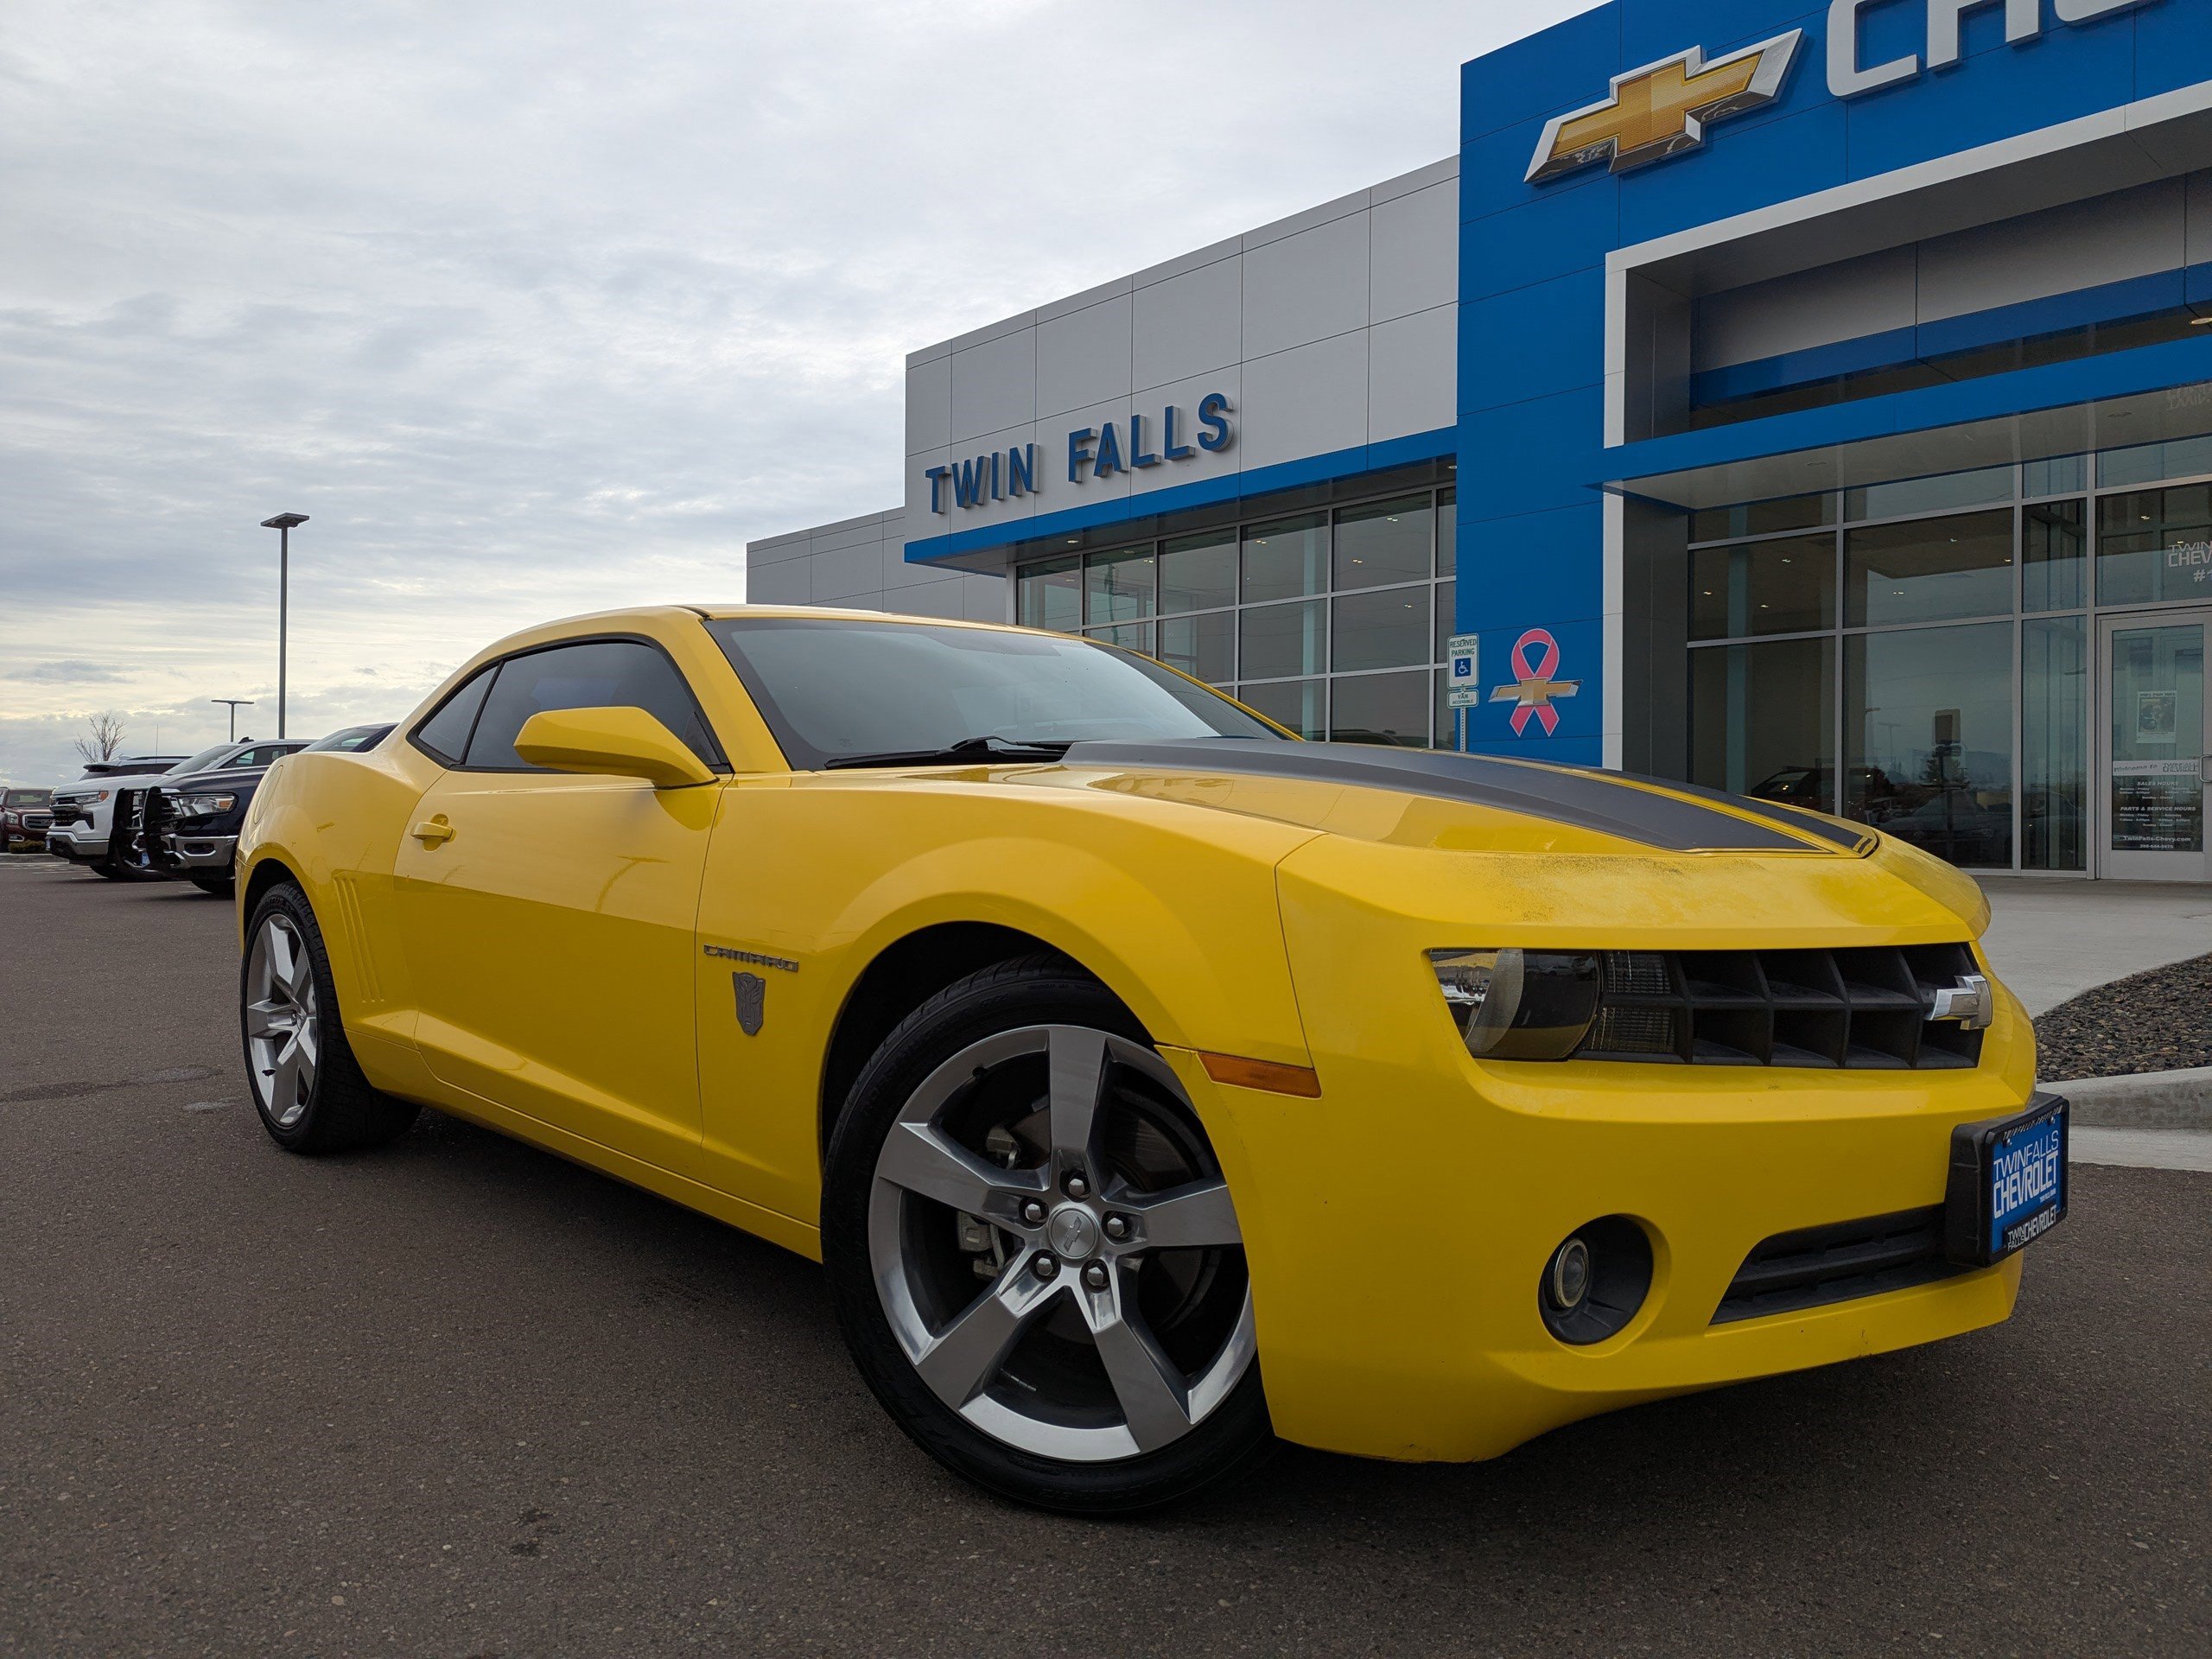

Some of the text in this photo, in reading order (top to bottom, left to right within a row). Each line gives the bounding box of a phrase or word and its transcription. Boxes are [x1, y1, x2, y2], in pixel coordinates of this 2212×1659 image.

[925, 392, 1235, 513] TWIN FALLS
[1450, 639, 1477, 647] RESERVED
[1451, 648, 1475, 657] PARKING
[703, 944, 799, 973] CAMARO
[1993, 1150, 2058, 1219] CHEVROLET
[2007, 1224, 2025, 1243] TWIN
[2024, 1204, 2057, 1242] CHEVROLET
[2007, 1235, 2025, 1252] FALLS
